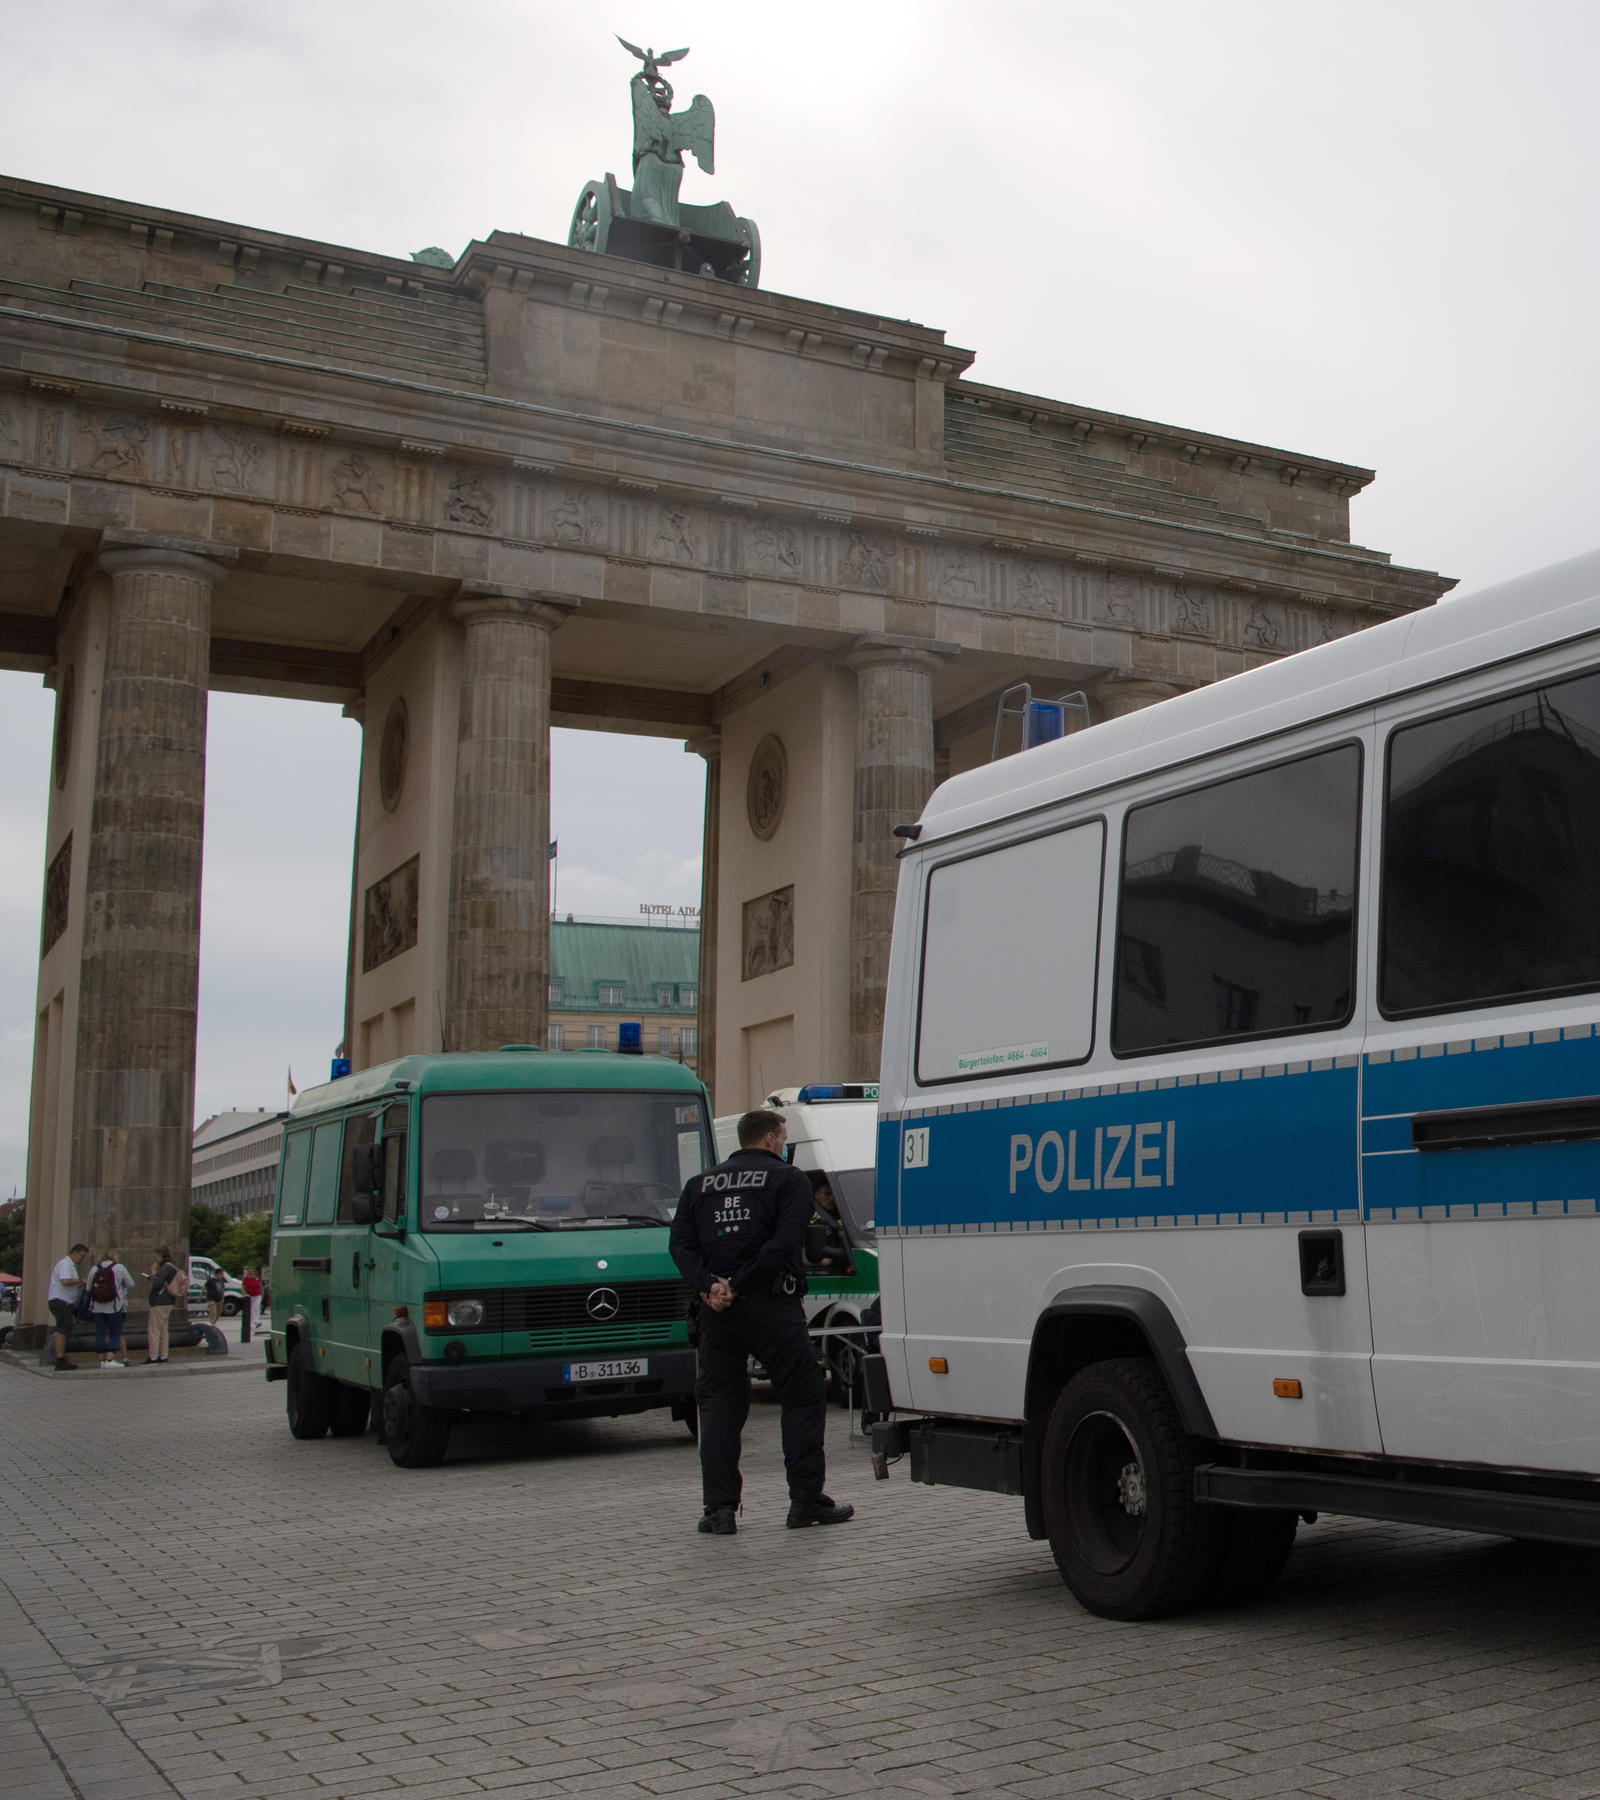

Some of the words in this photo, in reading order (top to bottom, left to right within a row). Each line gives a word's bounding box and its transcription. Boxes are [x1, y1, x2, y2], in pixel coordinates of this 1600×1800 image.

[640, 904, 674, 915] HOTEL
[906, 1132, 925, 1164] 31
[1009, 1120, 1176, 1194] POLIZEI
[701, 1171, 768, 1193] POLIZEI
[724, 1196, 741, 1208] BE
[714, 1208, 751, 1223] 31112
[579, 1365, 588, 1379] B
[598, 1361, 641, 1376] 31136
